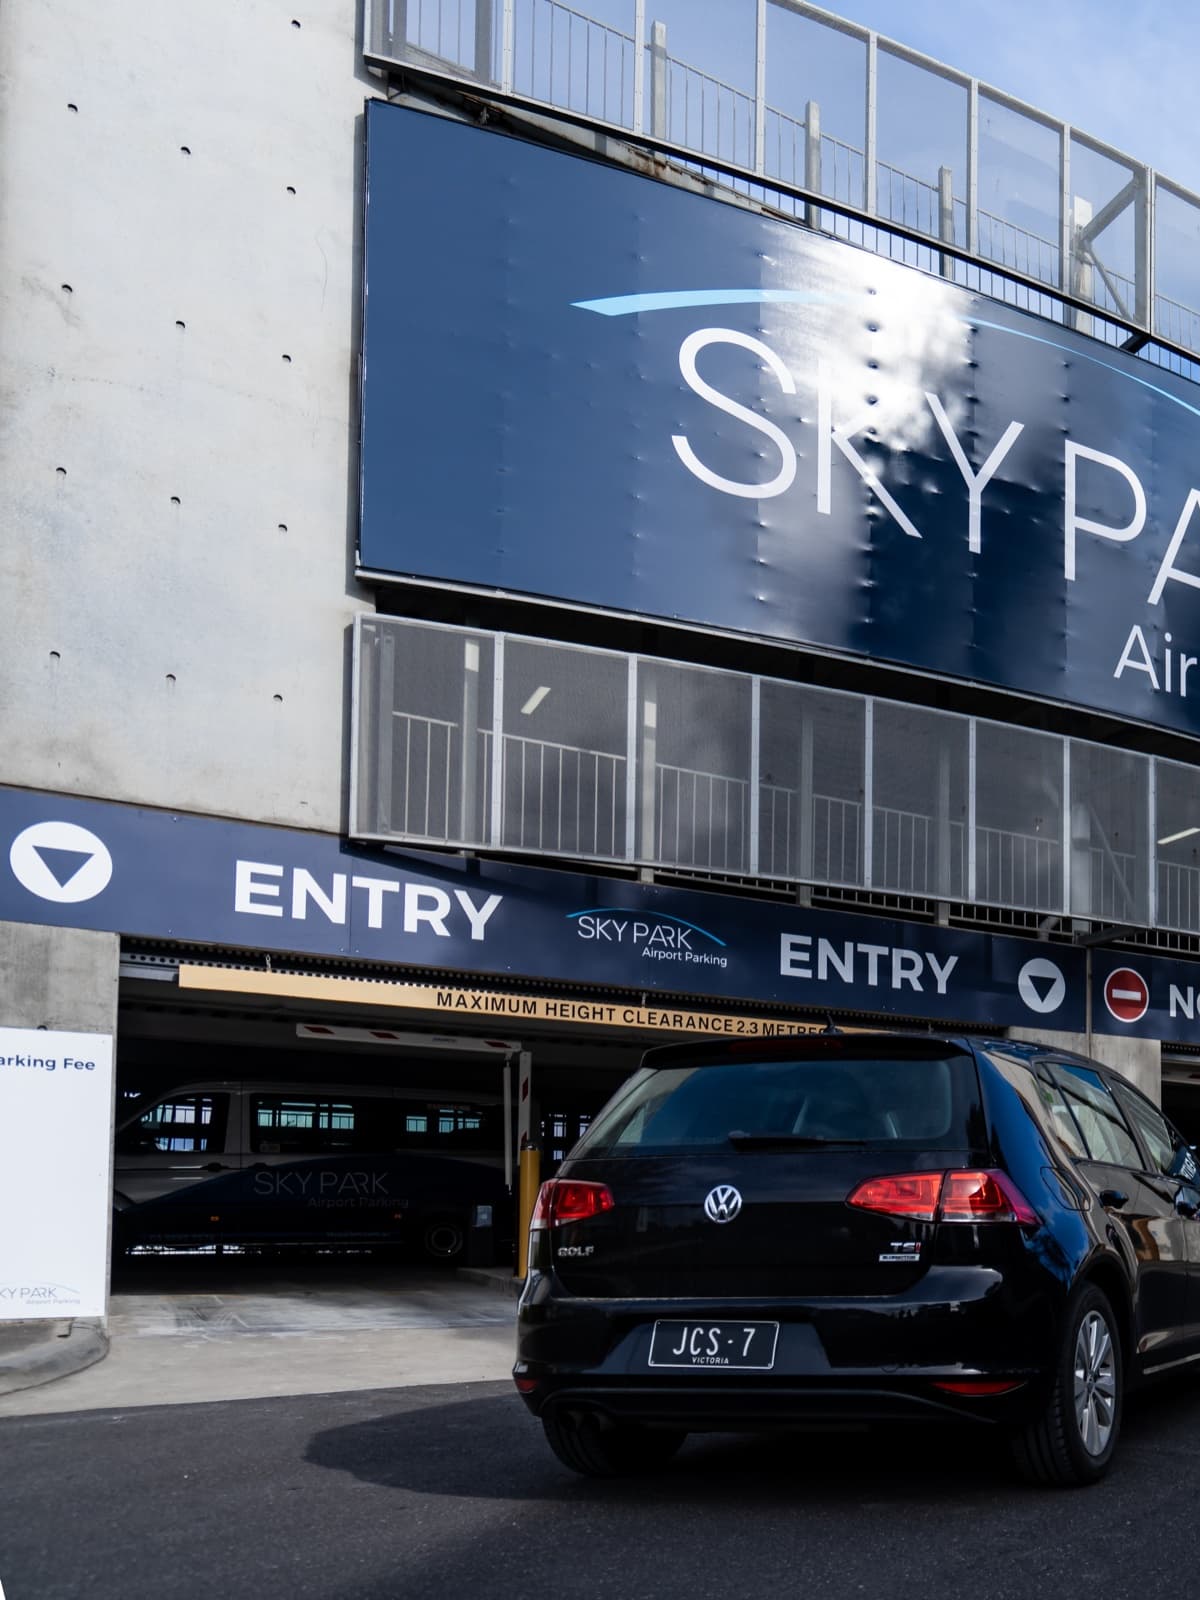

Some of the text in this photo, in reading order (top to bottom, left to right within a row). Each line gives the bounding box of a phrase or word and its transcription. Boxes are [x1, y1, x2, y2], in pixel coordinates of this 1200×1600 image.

[670, 325, 1024, 555] SKY
[233, 859, 504, 942] ENTRY
[577, 915, 693, 950] SKY PARK
[641, 946, 728, 968] Airport Parking
[779, 933, 959, 995] ENTRY
[436, 991, 538, 1016] MAXIMUM
[545, 1003, 617, 1024] HEIGHT
[622, 1009, 734, 1034] CLEARANCE
[736, 1018, 759, 1035] 2.3
[0, 1054, 96, 1072] arking Fee
[253, 1170, 391, 1196] SKY PARK
[306, 1196, 409, 1210] Airport Parking
[557, 1245, 595, 1257] GOLF
[20, 1287, 57, 1298] PARK
[691, 1357, 730, 1365] VICTORIA
